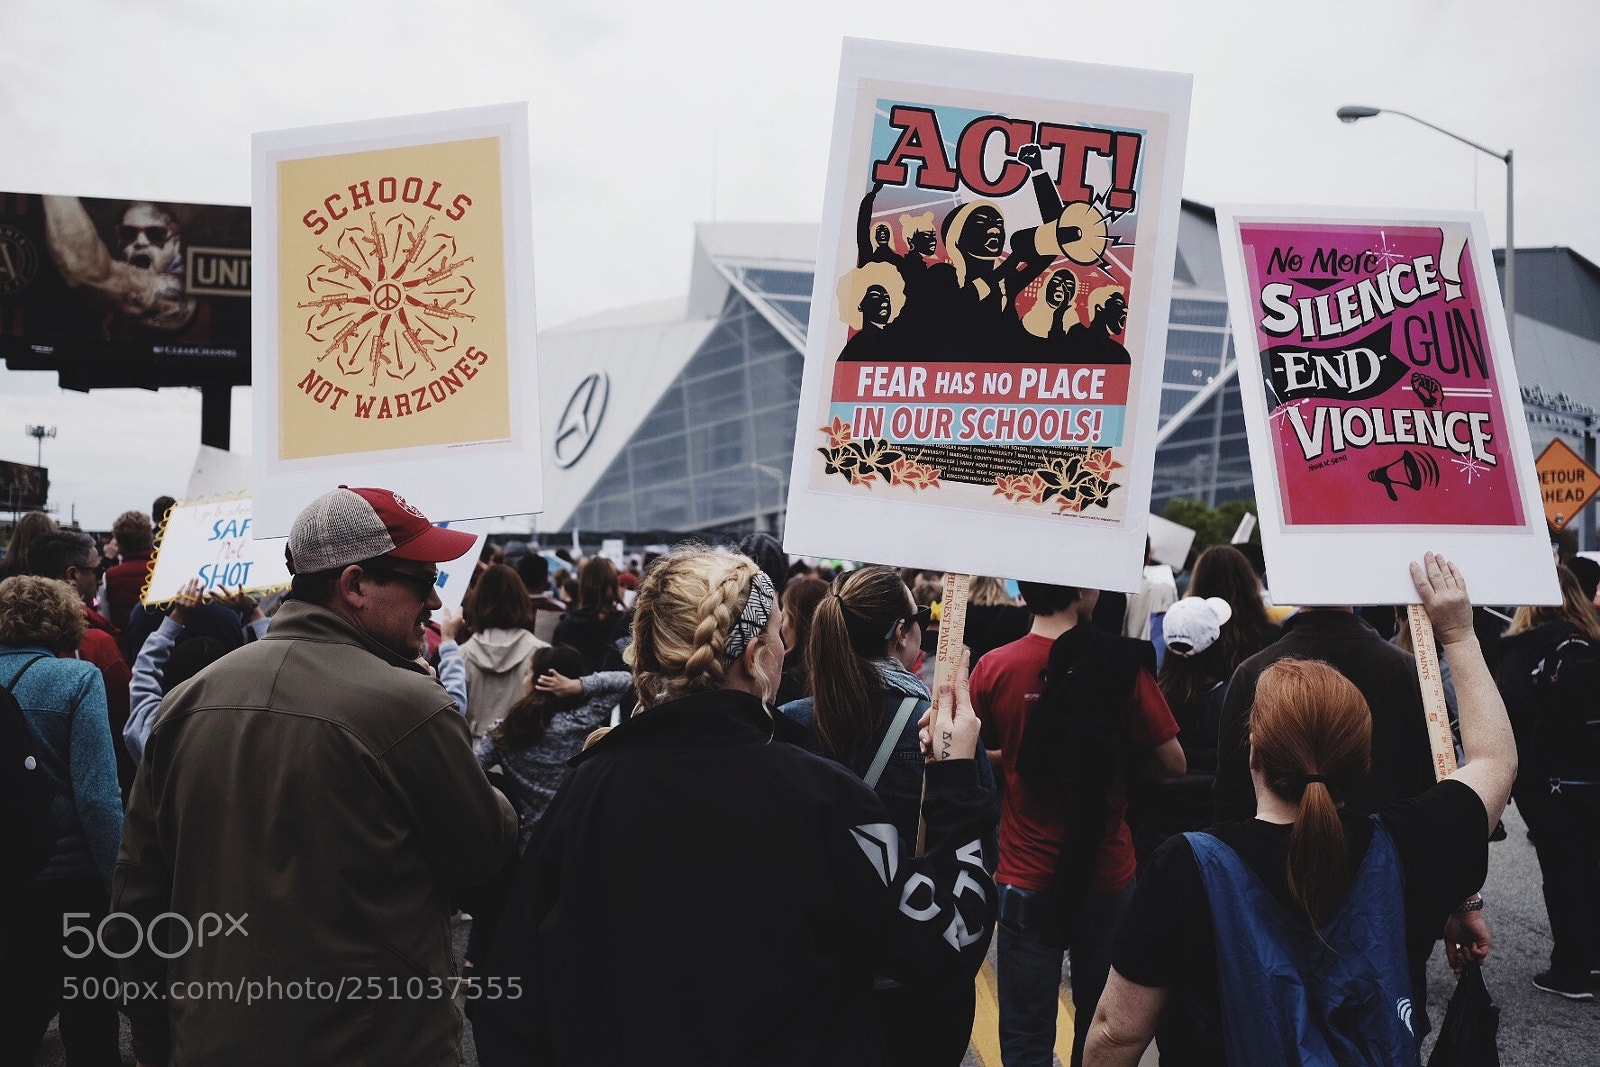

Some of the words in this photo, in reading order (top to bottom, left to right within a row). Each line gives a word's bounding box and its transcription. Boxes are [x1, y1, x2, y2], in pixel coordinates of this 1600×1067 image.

[872, 105, 1142, 212] ACT!
[302, 177, 472, 235] SCHOOLS
[197, 257, 250, 287] UNI
[1266, 246, 1304, 276] No
[1309, 247, 1379, 276] More
[1403, 308, 1489, 379] GUN
[297, 368, 349, 410] NOT
[354, 345, 488, 419] WARZONES
[857, 366, 927, 397] FEAR
[934, 371, 976, 395] HAS
[982, 372, 1013, 395] NO
[1019, 368, 1106, 400] PLACE
[852, 406, 885, 440] IN
[890, 406, 954, 440] OUR
[958, 407, 1103, 443] SCHOOLS!
[1286, 405, 1497, 467] VIOLENCE
[1538, 469, 1585, 485] ETOUR
[1543, 488, 1585, 503] HEAD
[208, 518, 252, 541] SAF
[198, 562, 254, 591] SHOT
[943, 589, 956, 624] FINEST
[938, 626, 950, 662] PAINTS
